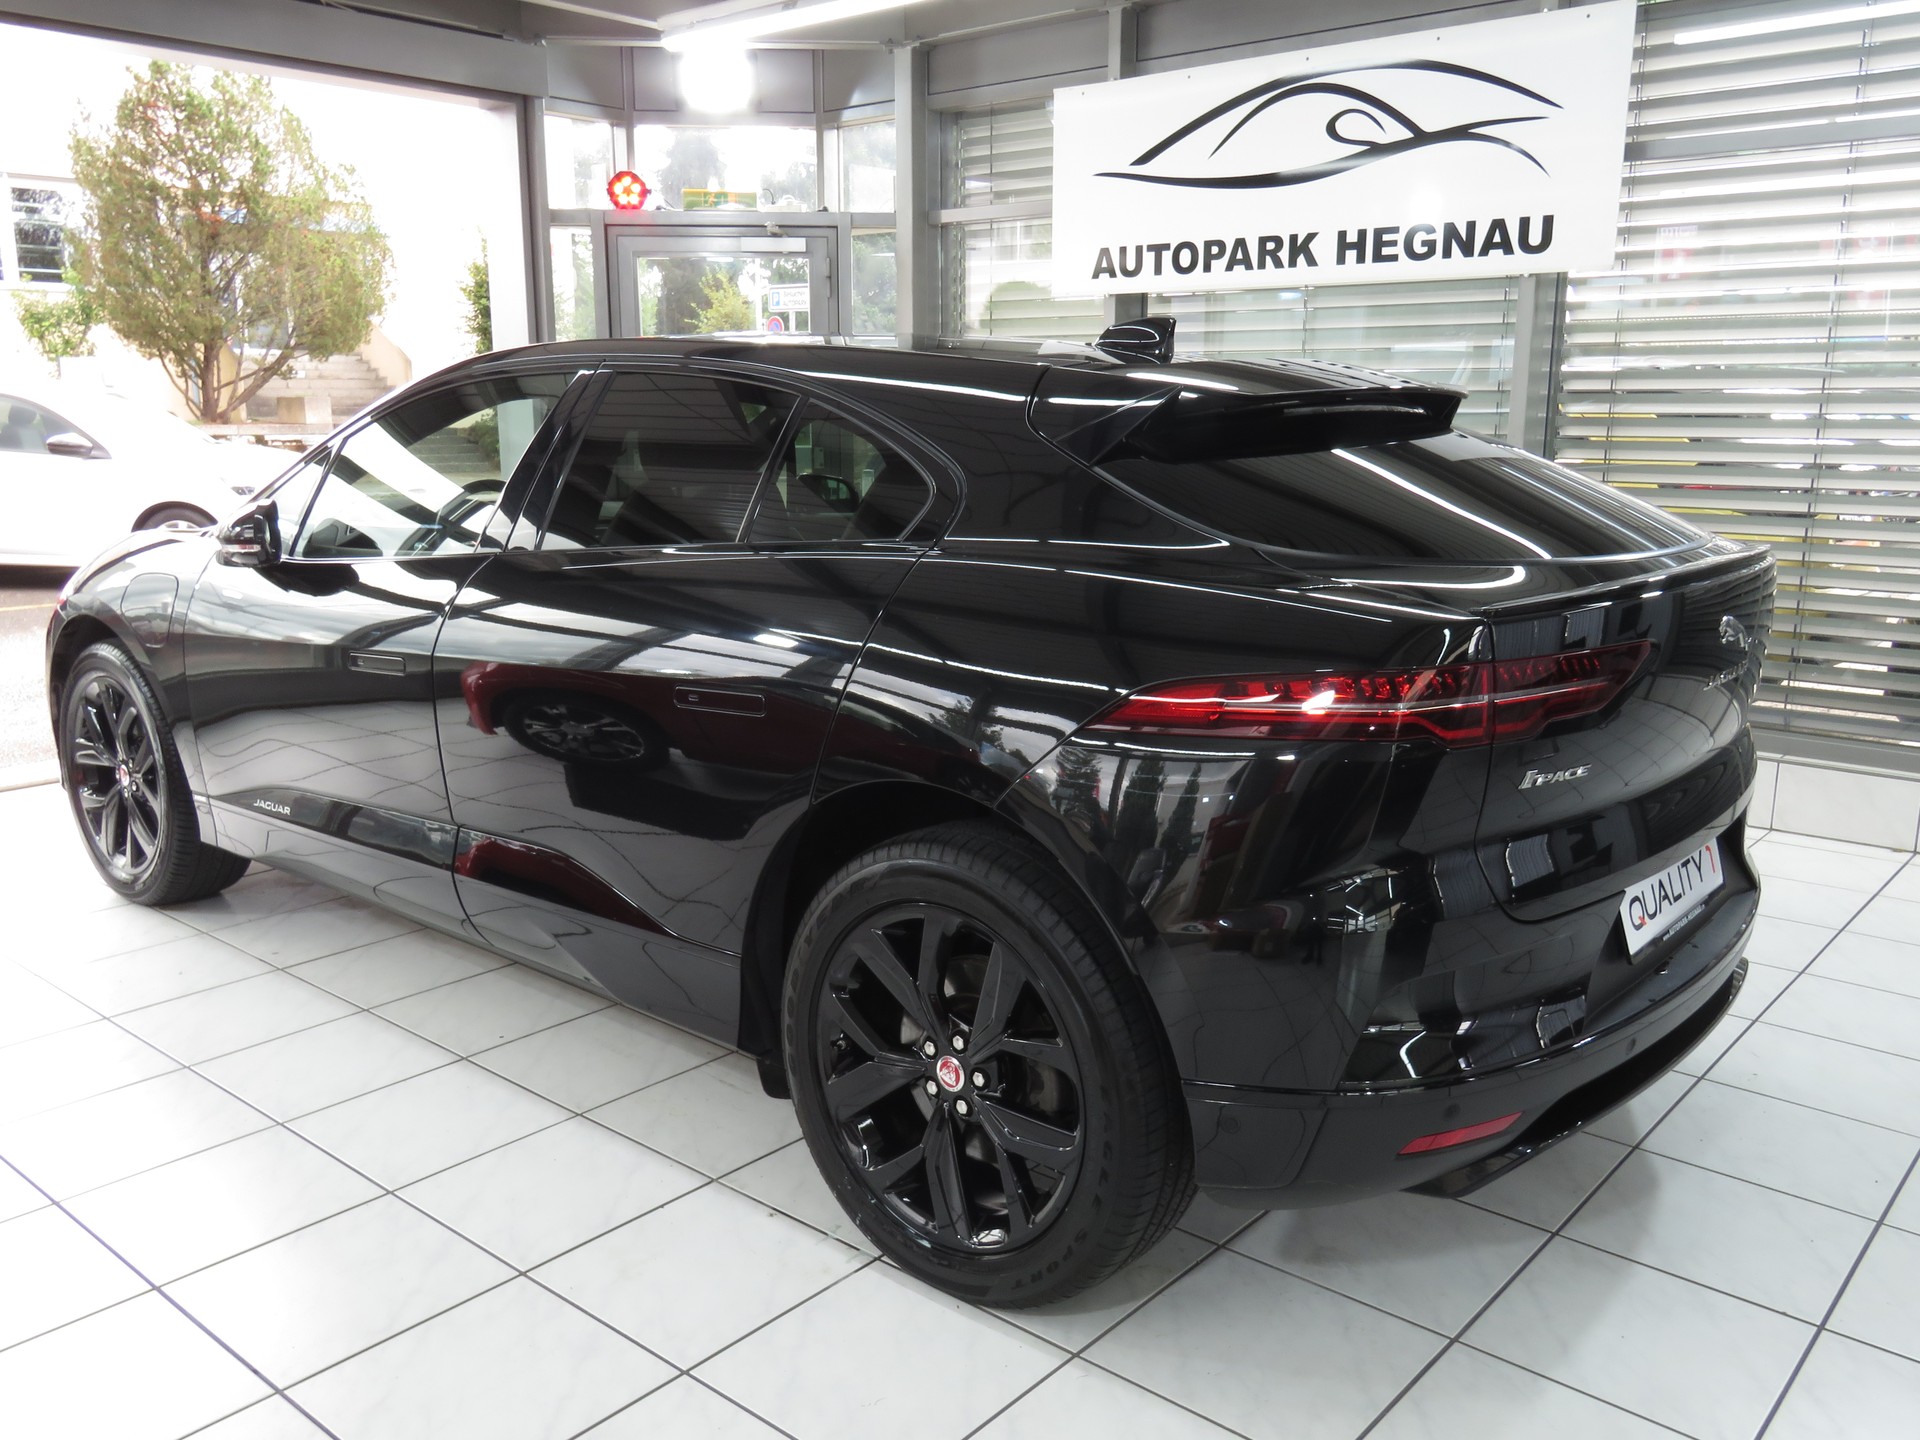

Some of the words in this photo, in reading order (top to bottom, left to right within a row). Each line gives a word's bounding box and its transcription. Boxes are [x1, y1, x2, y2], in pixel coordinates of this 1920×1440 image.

[1091, 231, 1320, 280] AUTOPARK
[1336, 215, 1554, 266] HEGNAU
[253, 798, 291, 816] JAGUAR
[1010, 1227, 1089, 1290] SPORT
